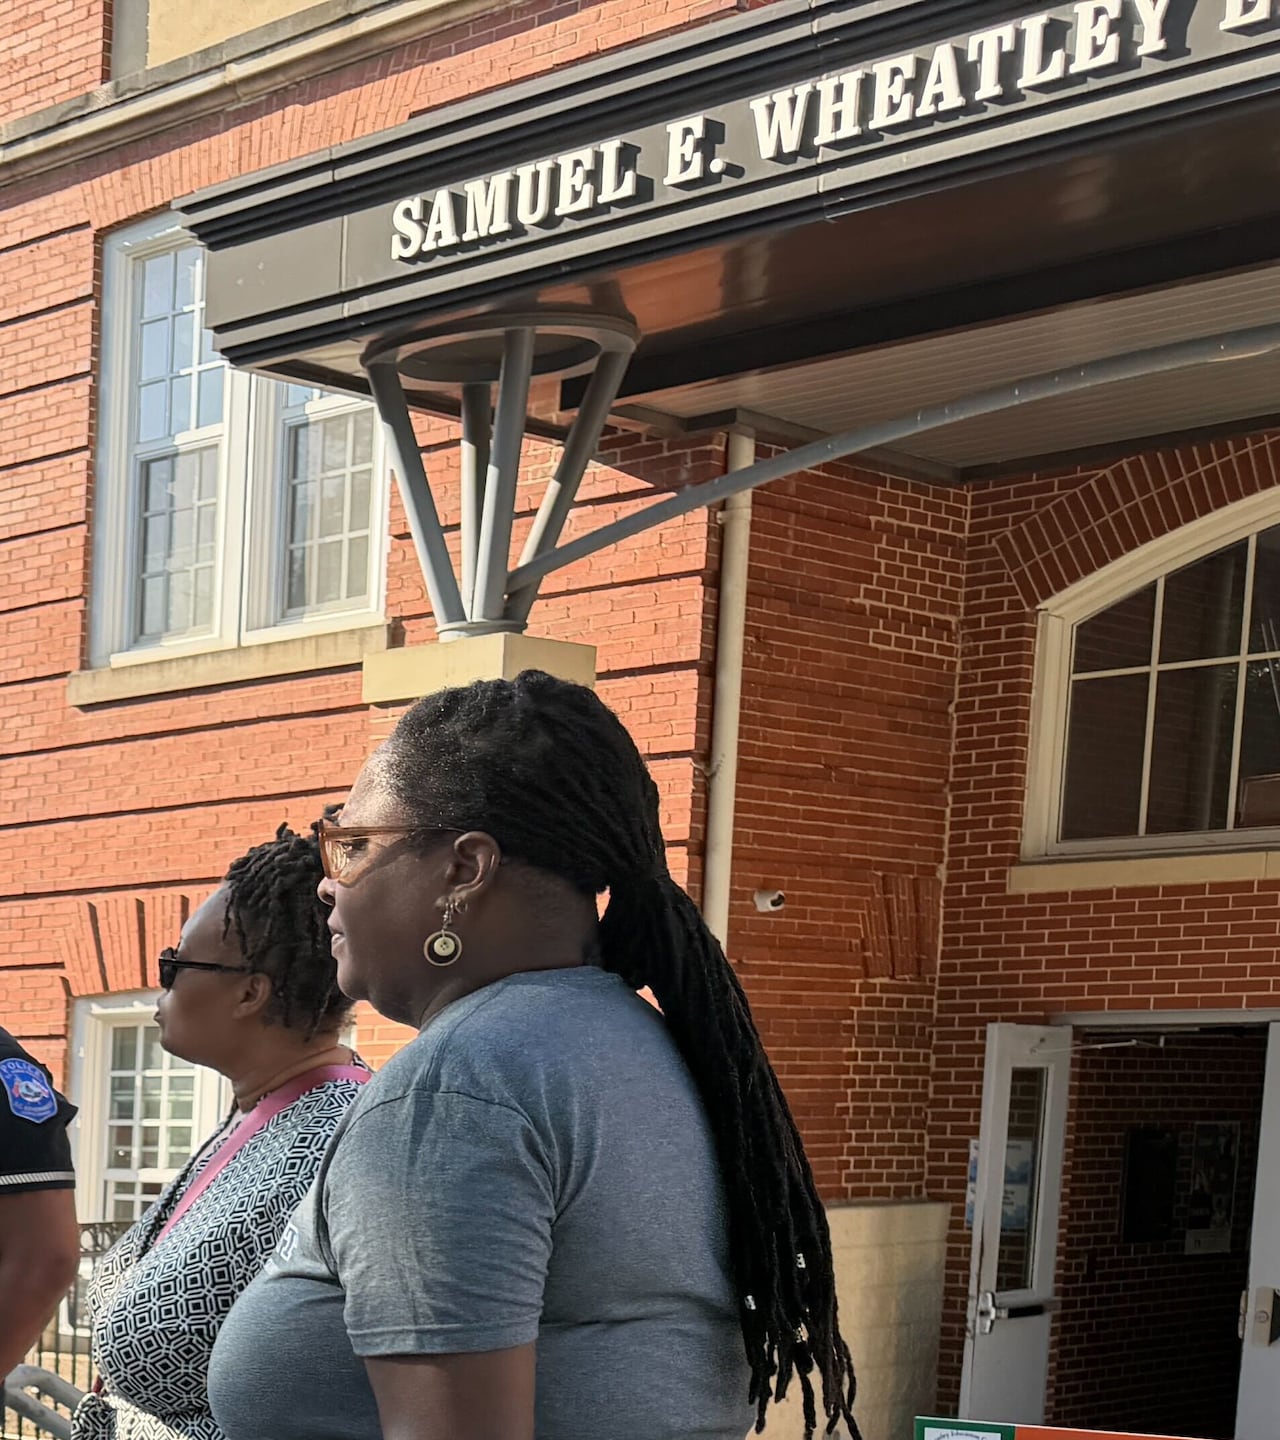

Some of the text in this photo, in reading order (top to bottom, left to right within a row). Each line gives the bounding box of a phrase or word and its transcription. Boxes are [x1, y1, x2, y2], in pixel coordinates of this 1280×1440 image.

[391, 0, 1170, 260] SAMUEL E. WHEATLEY
[0, 1061, 41, 1076] POLICE
